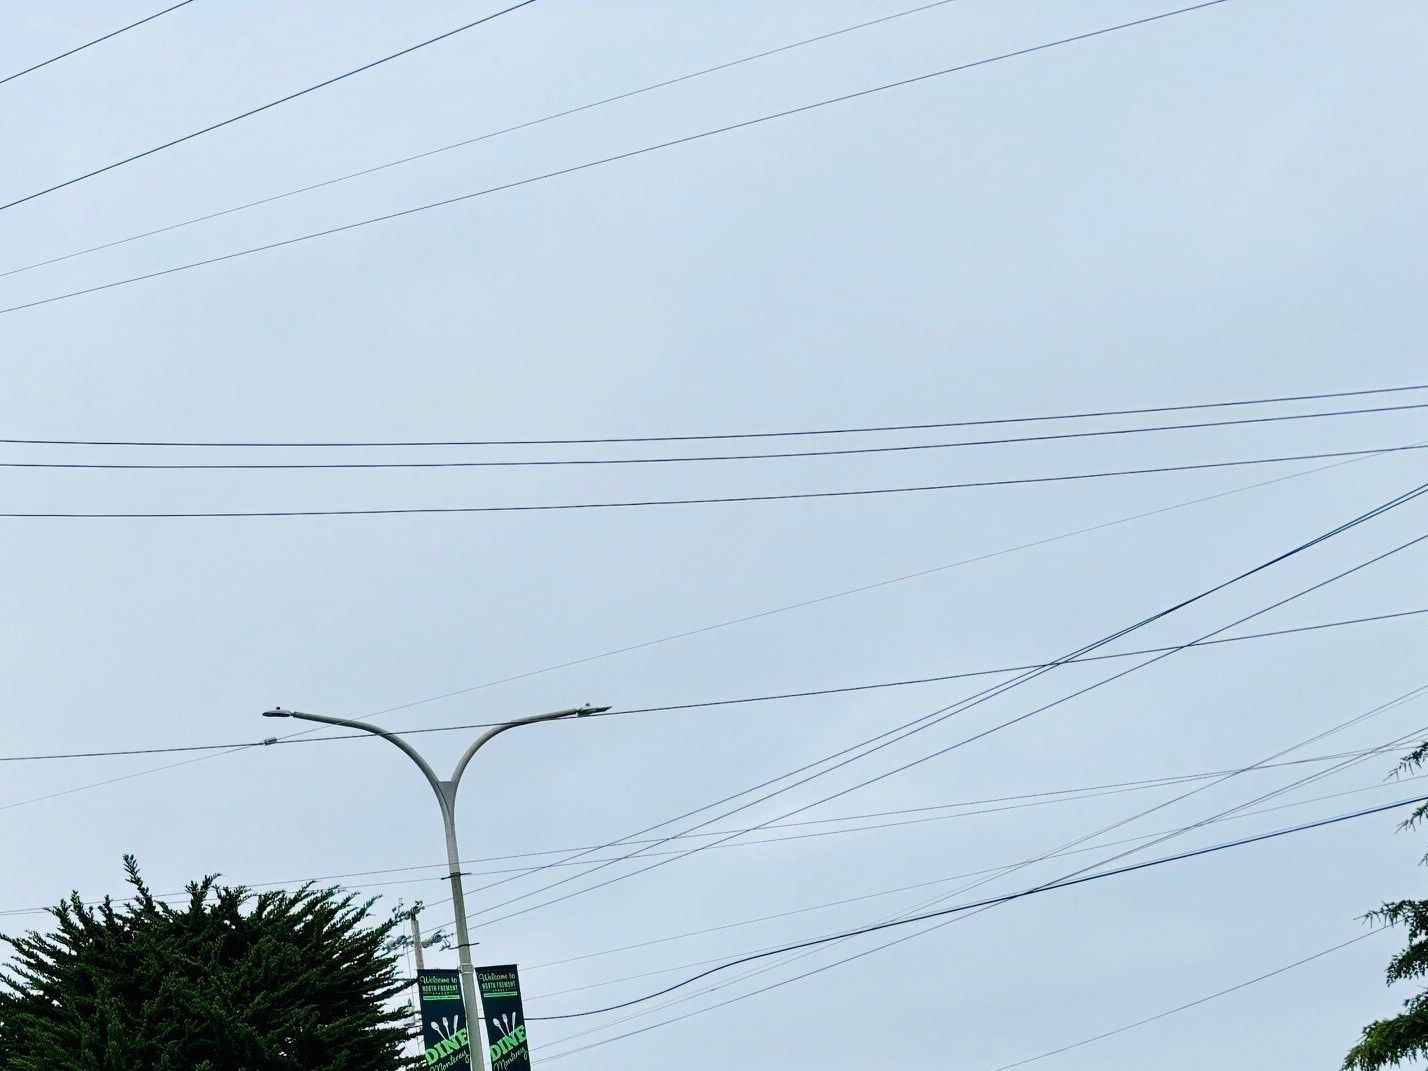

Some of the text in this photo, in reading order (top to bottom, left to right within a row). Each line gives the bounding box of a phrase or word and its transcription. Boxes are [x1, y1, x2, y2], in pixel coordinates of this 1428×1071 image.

[420, 975, 458, 984] Welcome to
[478, 972, 516, 982] Welcome to
[425, 1027, 468, 1066] DINE
[490, 1024, 527, 1062] DINE
